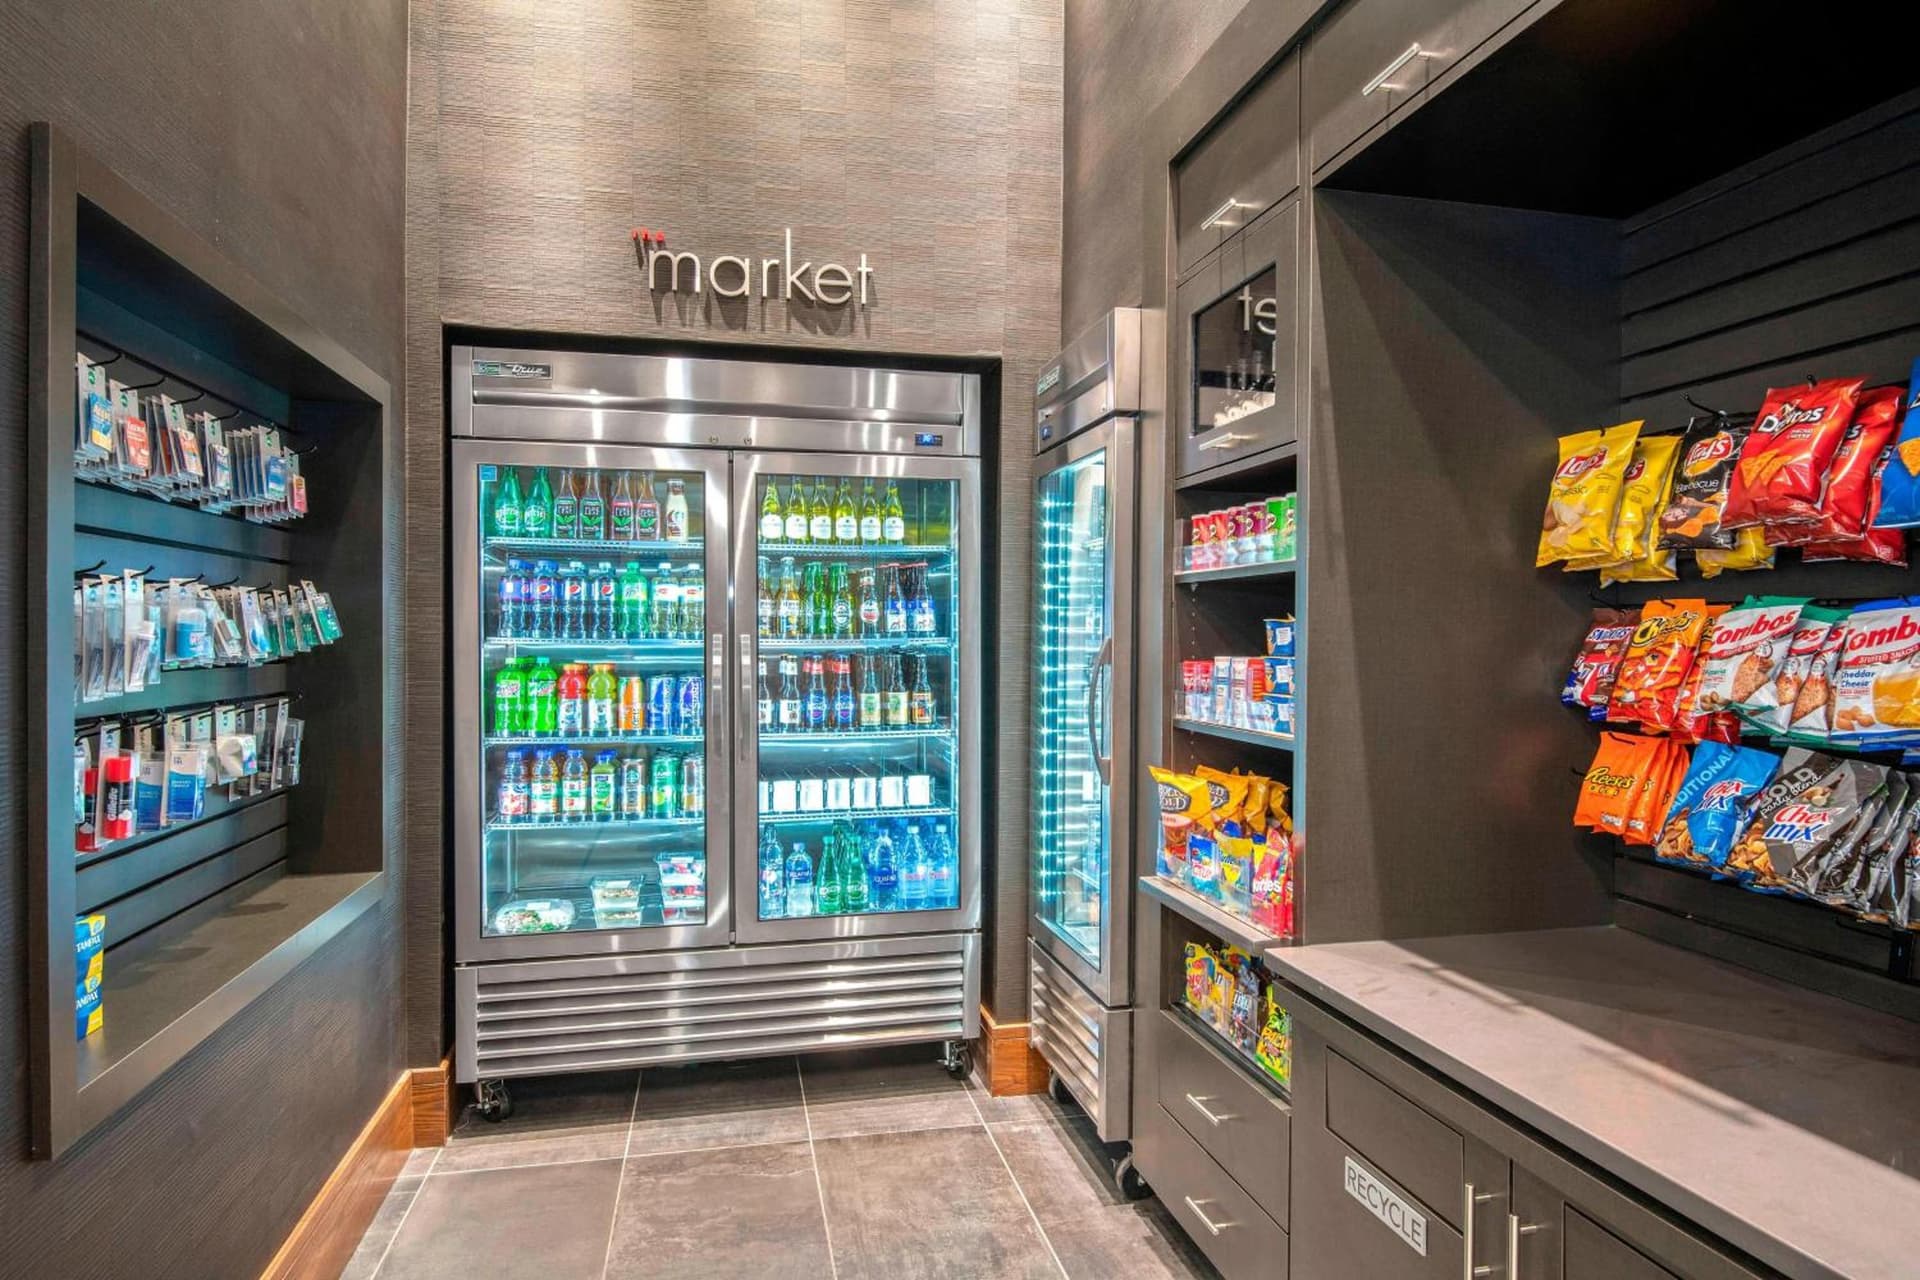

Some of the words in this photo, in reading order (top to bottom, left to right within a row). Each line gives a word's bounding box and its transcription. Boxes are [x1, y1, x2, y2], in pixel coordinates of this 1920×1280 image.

[648, 227, 874, 305] market
[1757, 402, 1825, 433] Doritos
[1845, 615, 1920, 652] omb
[1347, 1166, 1422, 1248] RECYCLE
